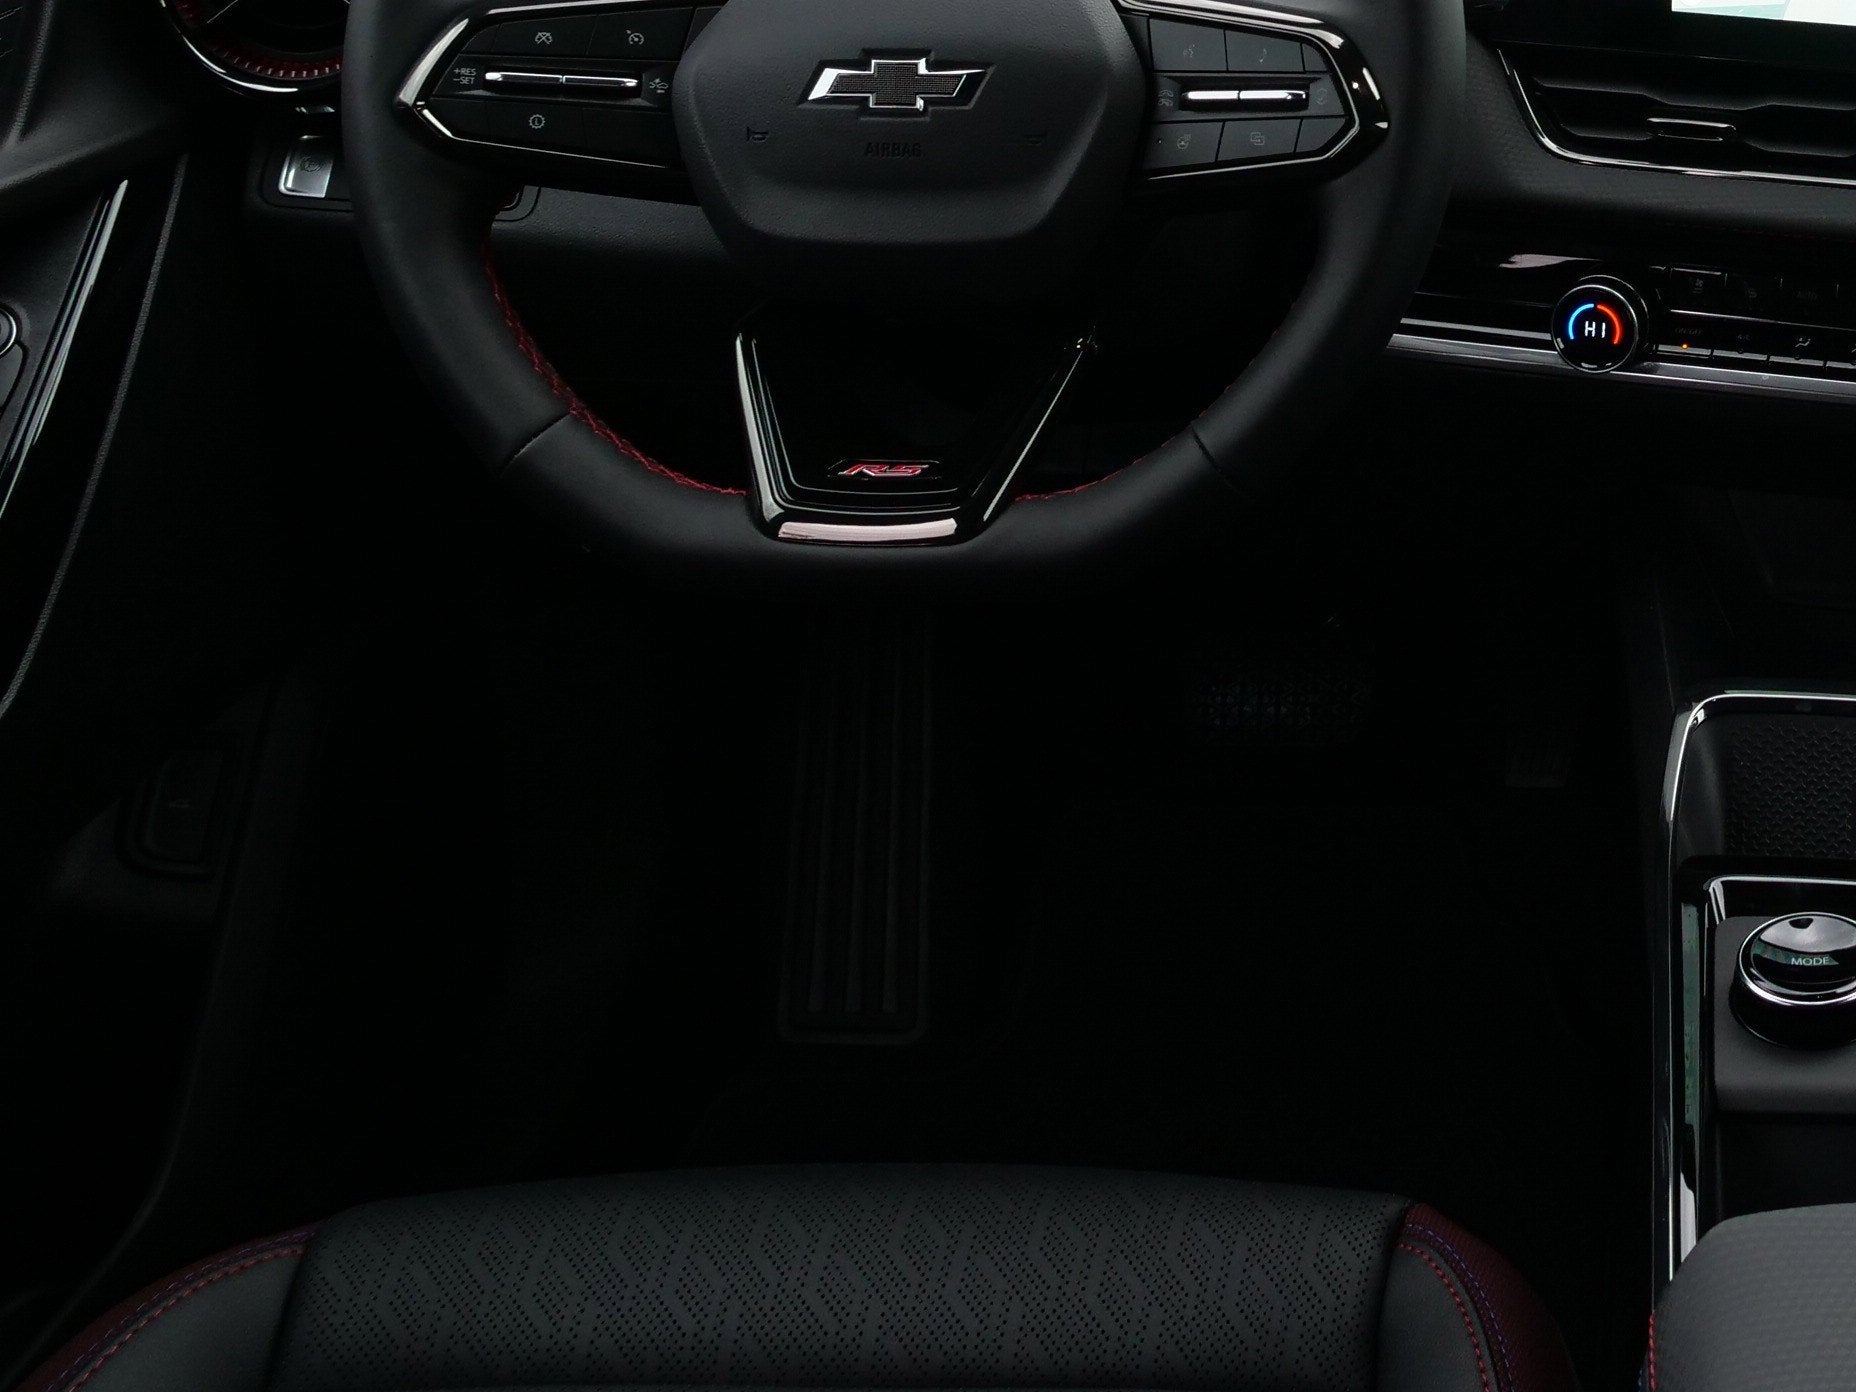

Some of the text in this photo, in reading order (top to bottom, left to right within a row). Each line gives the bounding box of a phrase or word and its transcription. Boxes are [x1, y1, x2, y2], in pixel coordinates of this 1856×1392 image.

[1584, 321, 1607, 338] HI
[837, 463, 930, 477] RS
[1791, 956, 1830, 966] MODE
